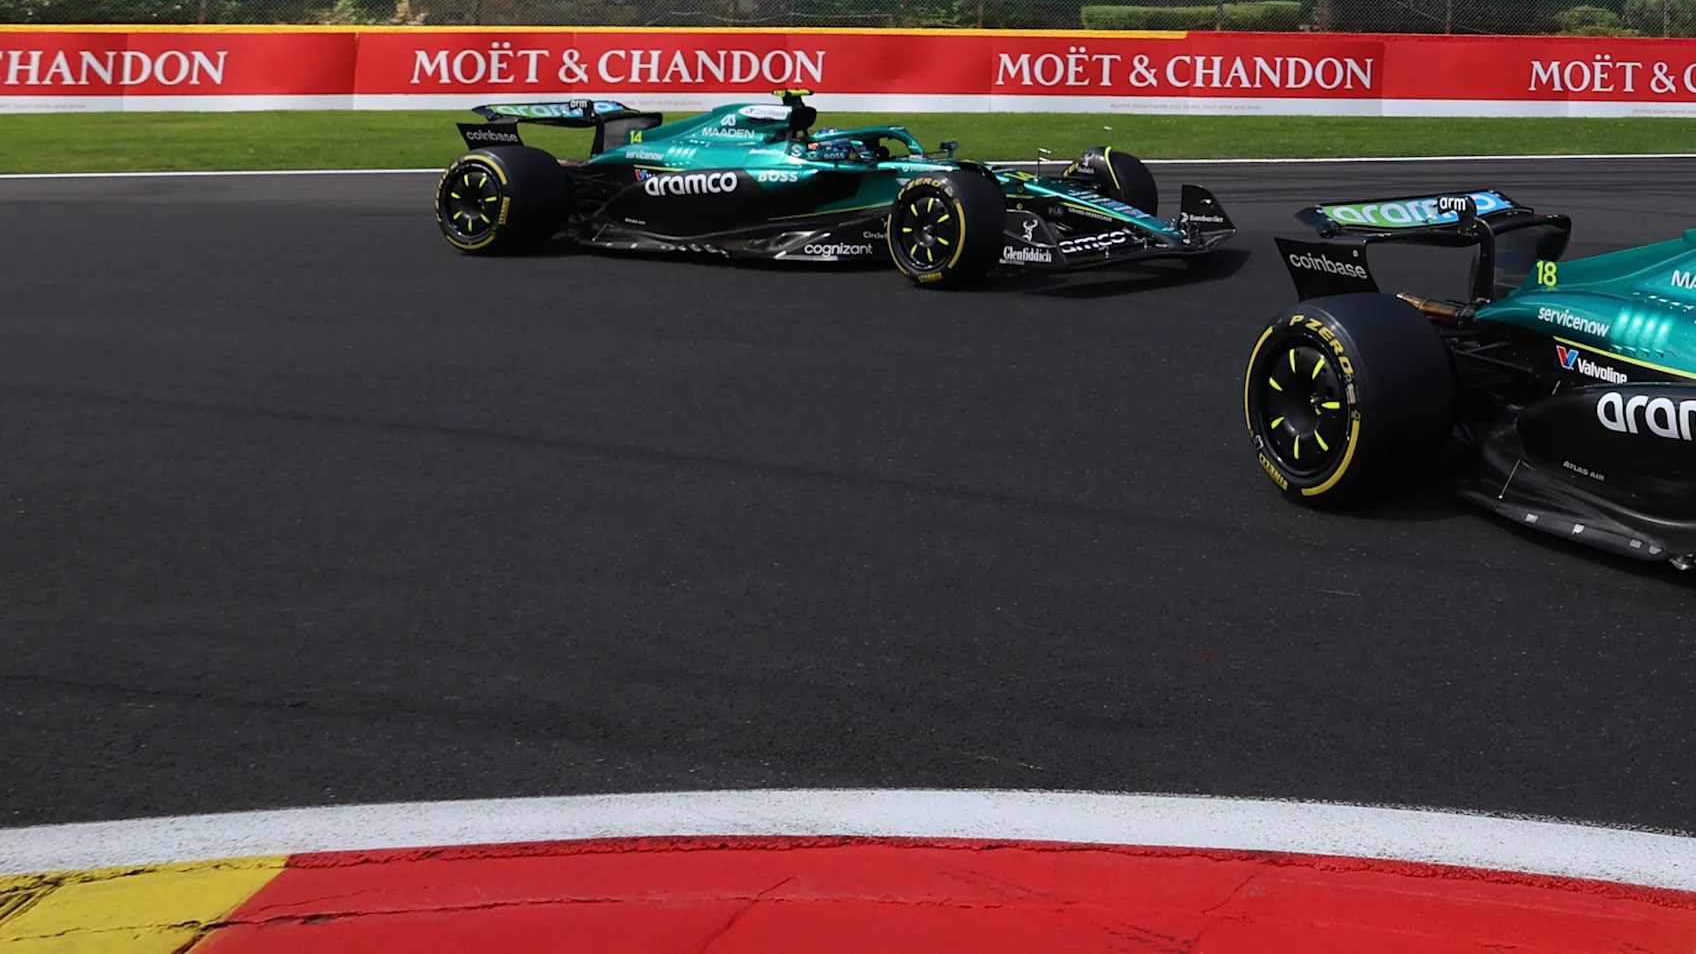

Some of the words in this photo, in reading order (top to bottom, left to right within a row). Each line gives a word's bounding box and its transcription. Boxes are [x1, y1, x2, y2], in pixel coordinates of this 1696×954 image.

[0, 50, 228, 85] HANDON
[410, 41, 549, 84] MOËT
[558, 48, 589, 84] &
[598, 48, 826, 84] CHANDON
[995, 46, 1121, 86] MOËT
[1128, 54, 1159, 87] &
[1166, 55, 1373, 89] CHANDON
[1528, 53, 1643, 93] MOËT
[1649, 62, 1677, 94] &
[497, 101, 611, 118] arao
[570, 99, 587, 109] arm
[466, 129, 518, 144] coinbase
[629, 130, 643, 144] 14
[702, 127, 755, 138] MAADEN
[645, 171, 738, 196] aramco
[758, 170, 798, 183] BOSS
[906, 177, 942, 190] ZERO
[1331, 191, 1497, 225] arao
[1439, 196, 1467, 212] arm
[804, 243, 873, 257] cognizant
[1003, 245, 1053, 263] Glenfiddich
[1059, 231, 1126, 254] amco
[1289, 252, 1368, 280] coinbase
[1537, 260, 1557, 286] 18
[1538, 306, 1609, 338] servicenow
[1289, 315, 1304, 326] P
[1305, 318, 1355, 375] ZERO
[1576, 358, 1628, 384] Valvoline
[1563, 460, 1588, 477] ATLAS
[1589, 471, 1605, 483] AIR
